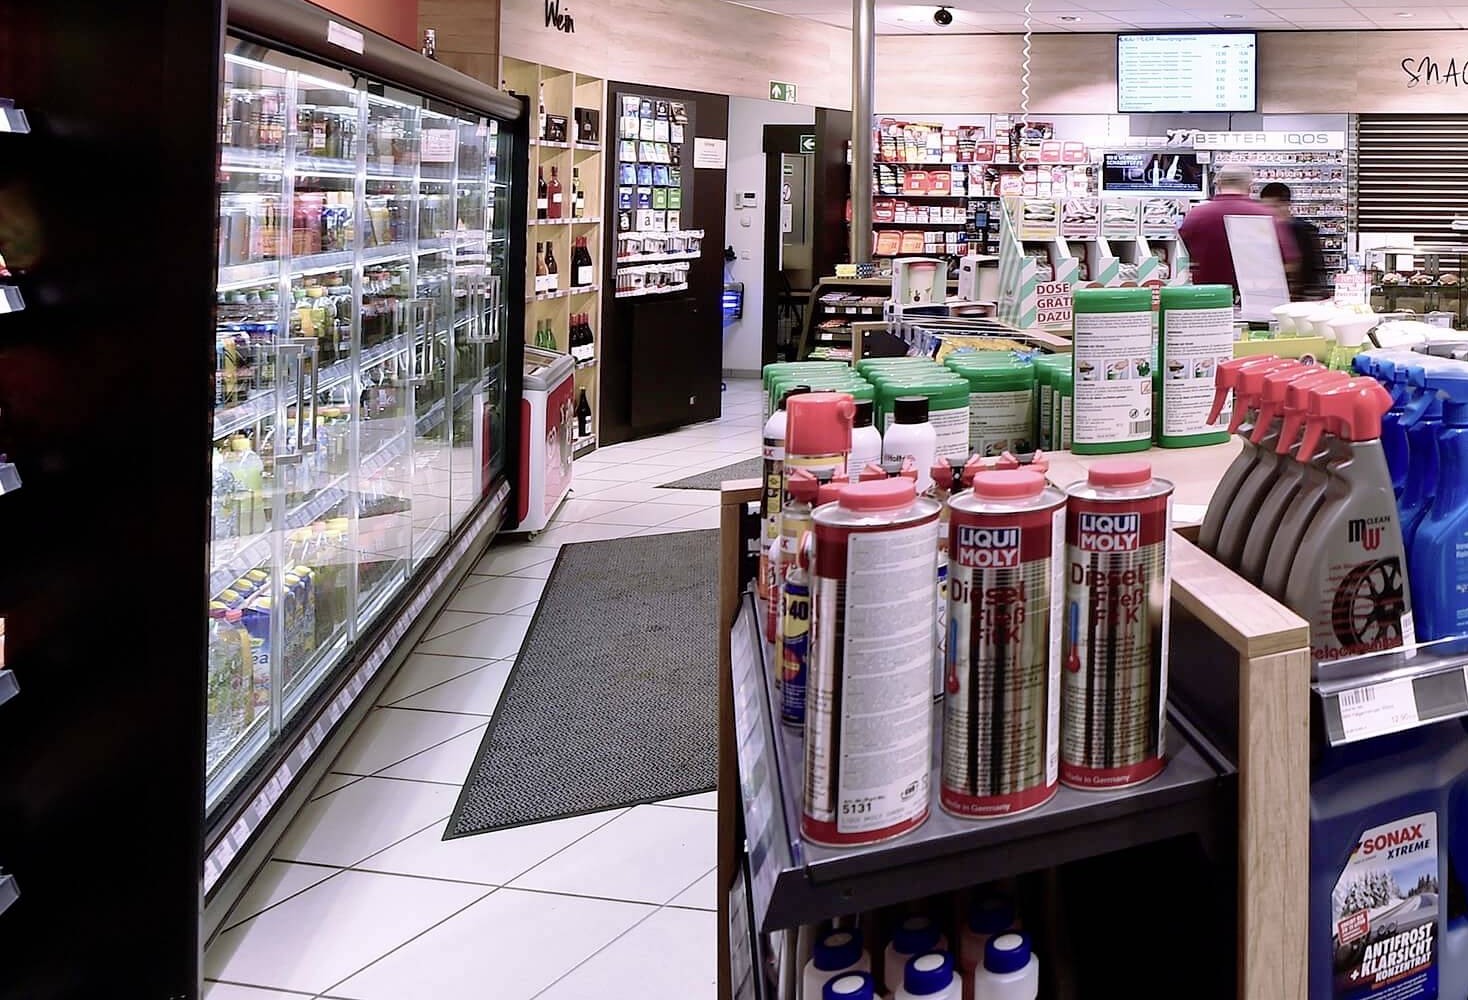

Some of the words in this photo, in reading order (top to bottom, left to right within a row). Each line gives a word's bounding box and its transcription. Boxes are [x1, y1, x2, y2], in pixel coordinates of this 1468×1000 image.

[1194, 133, 1268, 145] BETTER
[1282, 133, 1330, 146] IQOS
[1036, 283, 1070, 295] DOSE
[1037, 310, 1071, 323] DAZU
[1081, 514, 1137, 533] LIQUI
[959, 527, 1018, 549] LIQUI
[1080, 532, 1138, 550] MOLY
[958, 549, 1018, 568] MOLY
[1071, 563, 1145, 588] Diesel
[951, 579, 1028, 605] Diesel
[842, 802, 872, 815] 5131
[970, 803, 1012, 814] Germany
[1363, 823, 1423, 855] SONAX
[1387, 839, 1431, 860] XTREME
[1363, 922, 1434, 962] ANTIFROST
[1360, 937, 1434, 978] KLARSICHT
[1375, 952, 1433, 983] KONZENTRAT
